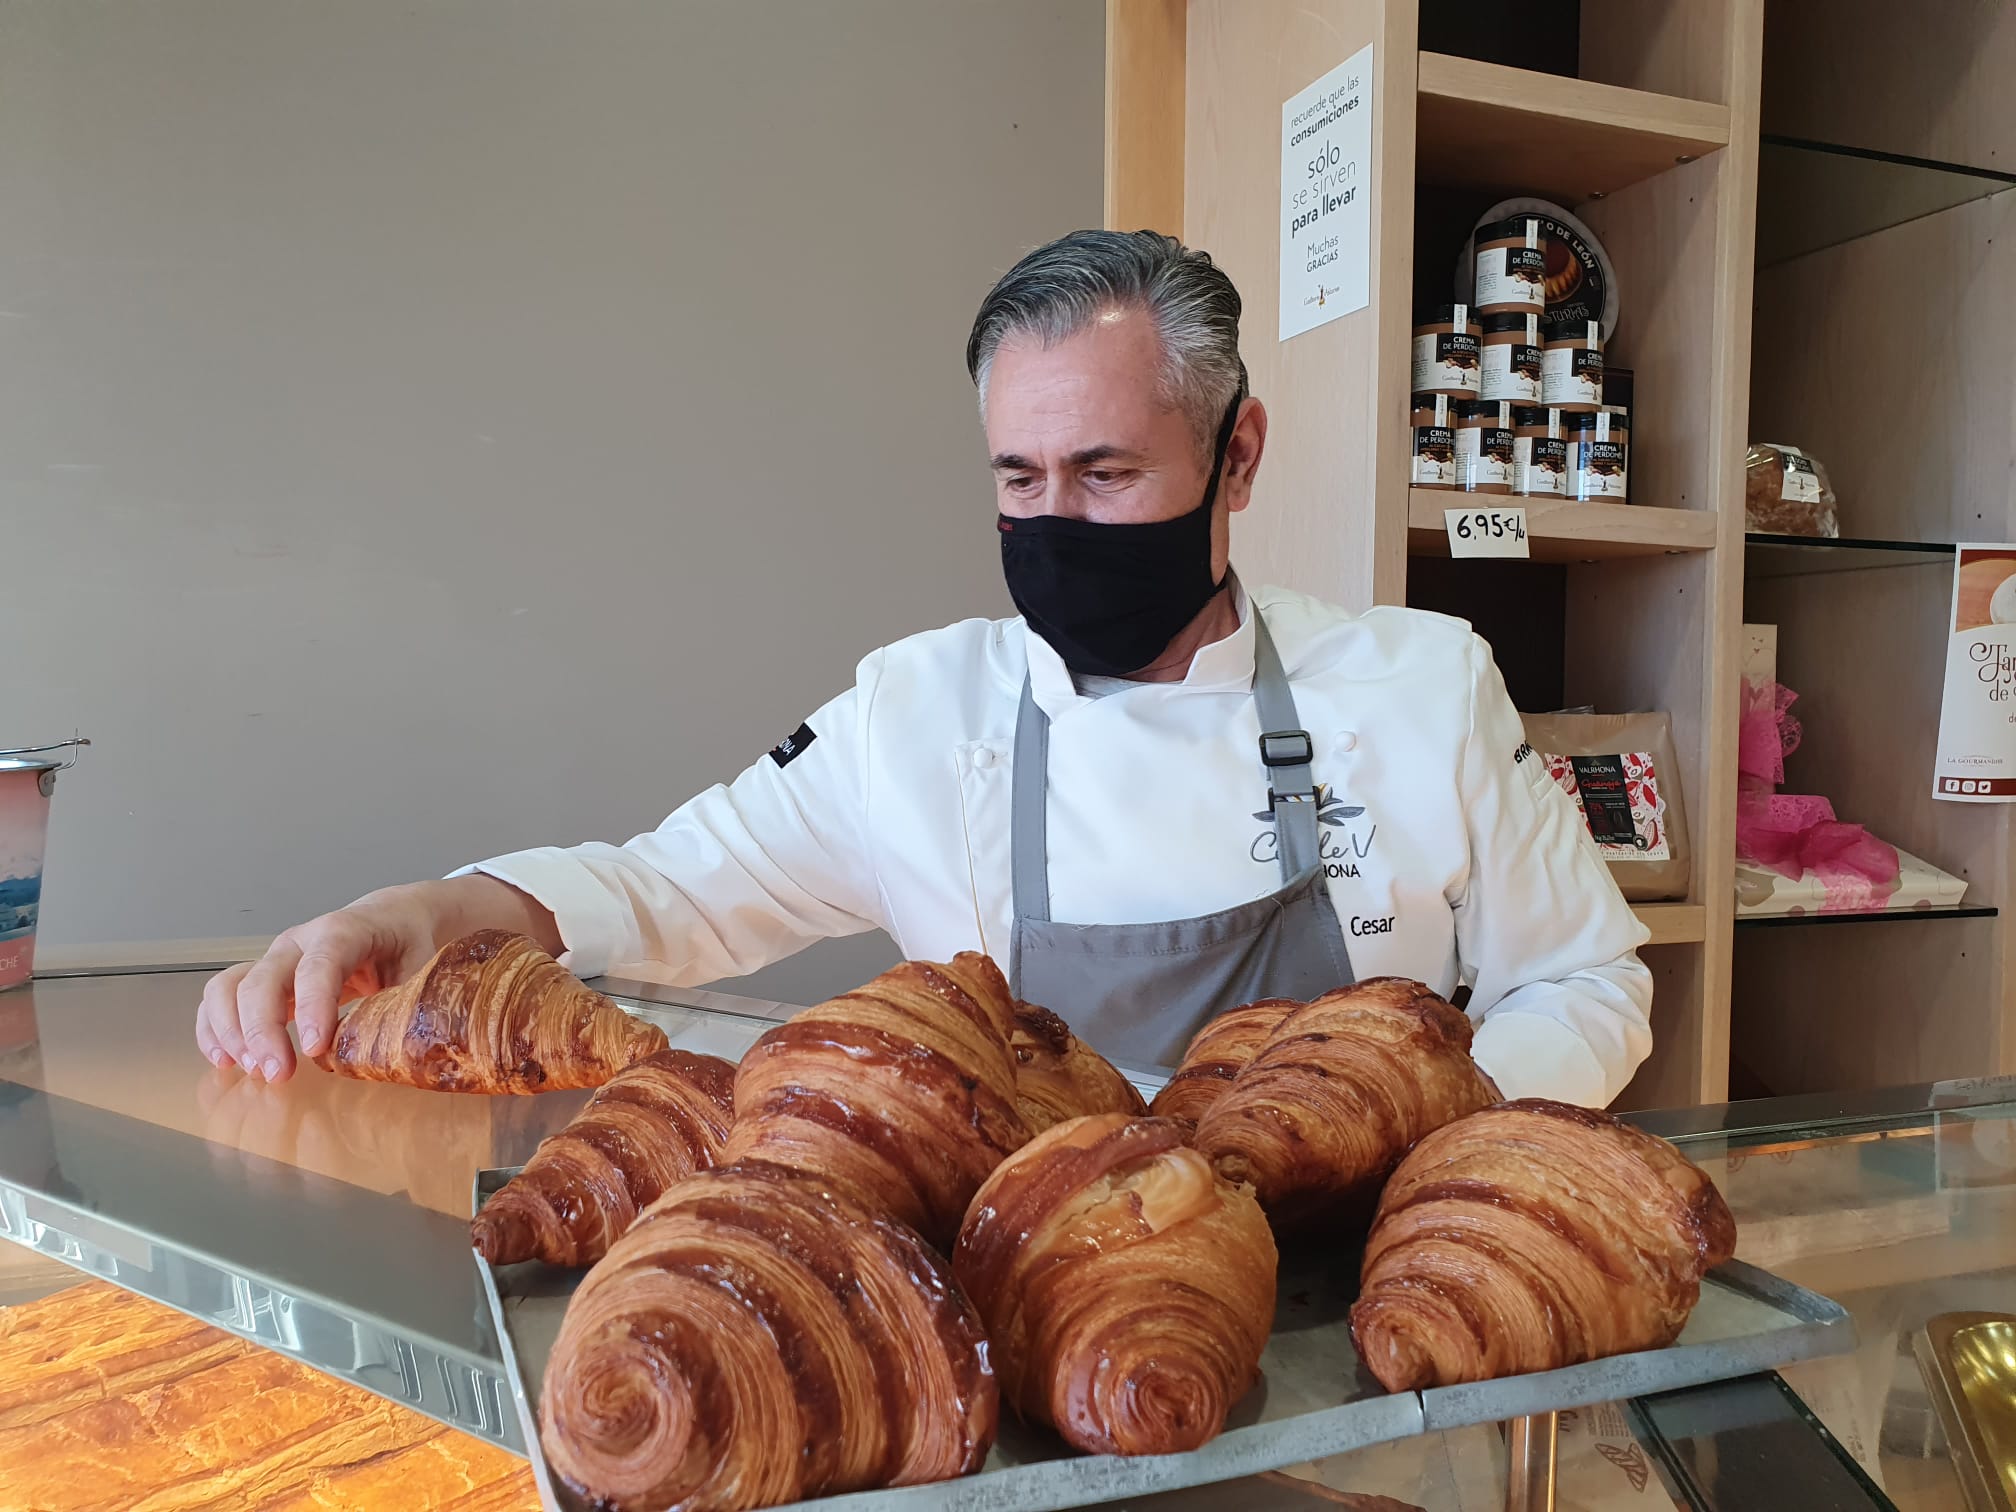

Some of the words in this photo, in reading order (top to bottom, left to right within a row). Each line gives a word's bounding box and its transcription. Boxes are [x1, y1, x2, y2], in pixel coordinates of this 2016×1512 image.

[1291, 94, 1327, 128] recuerde
[1328, 86, 1345, 108] que
[1347, 75, 1359, 92] las
[1291, 95, 1359, 147] consumiciones
[1308, 139, 1340, 179] sólo
[1292, 189, 1308, 209] se
[1313, 161, 1356, 199] sirven
[1291, 208, 1319, 239] para
[1322, 186, 1356, 217] llevar
[1307, 235, 1339, 259] Muchas
[1556, 226, 1571, 240] DE
[1572, 240, 1595, 269] LEÓN
[1306, 249, 1339, 273] GRACIAS
[1453, 336, 1475, 345] CREMA
[1430, 430, 1450, 438] CREMA
[1594, 444, 1617, 452] CREMA
[1989, 680, 2009, 701] de
[1579, 766, 1616, 774] VALRHONA
[1352, 825, 1376, 858] V
[1350, 916, 1395, 937] Cesar
